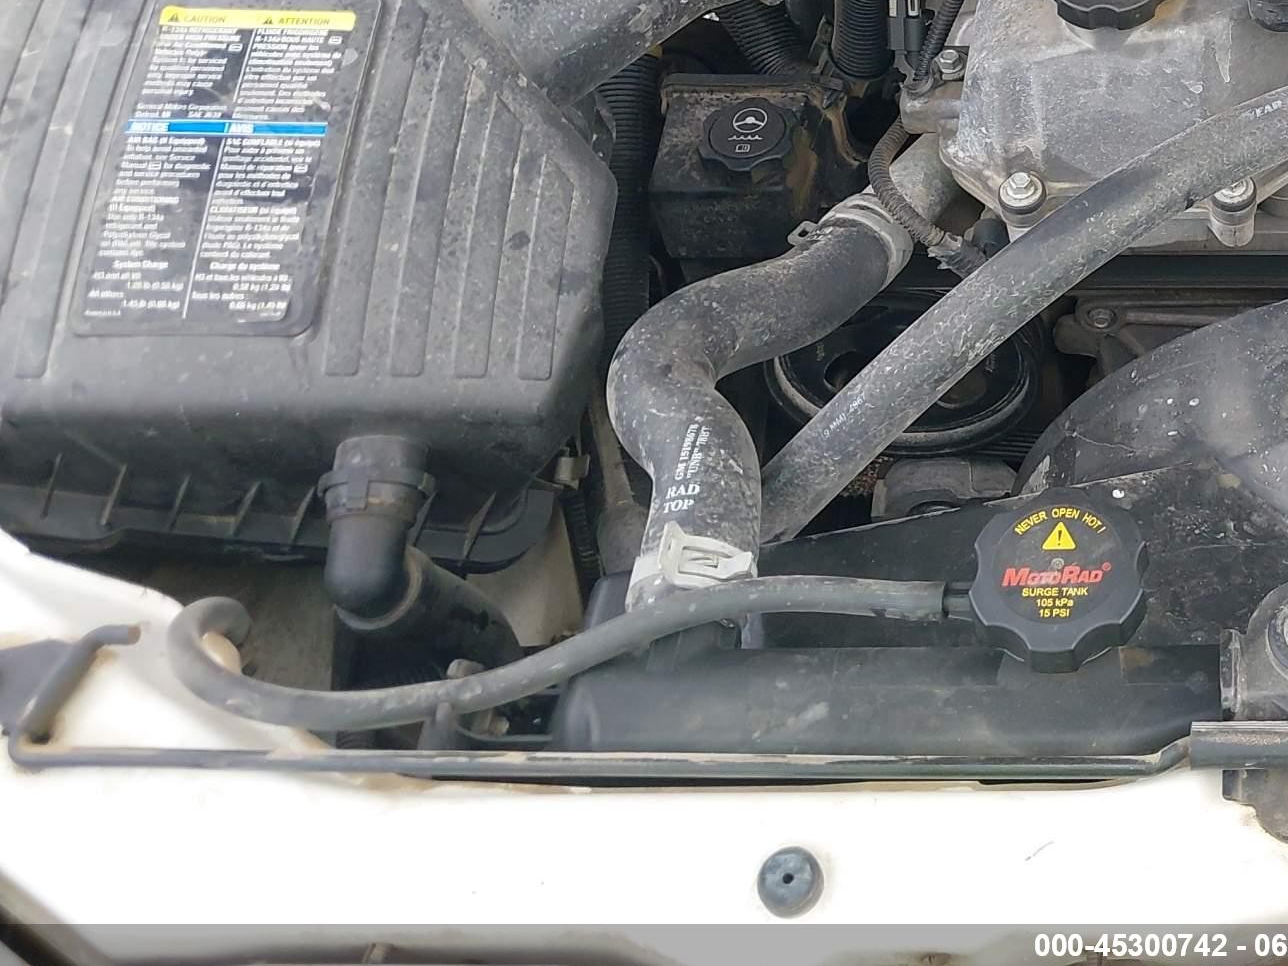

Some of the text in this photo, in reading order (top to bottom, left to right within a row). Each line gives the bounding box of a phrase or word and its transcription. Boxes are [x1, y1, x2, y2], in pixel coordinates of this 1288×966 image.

[278, 17, 331, 26] ATTENTION
[665, 482, 700, 500] RAD
[662, 498, 695, 514] TOP
[1014, 510, 1048, 535] NEVER
[1051, 507, 1080, 519] OPEN
[1021, 586, 1089, 597] SURGE TANK
[1035, 597, 1074, 607] 105 kPa
[1039, 608, 1070, 618] 15 PSI
